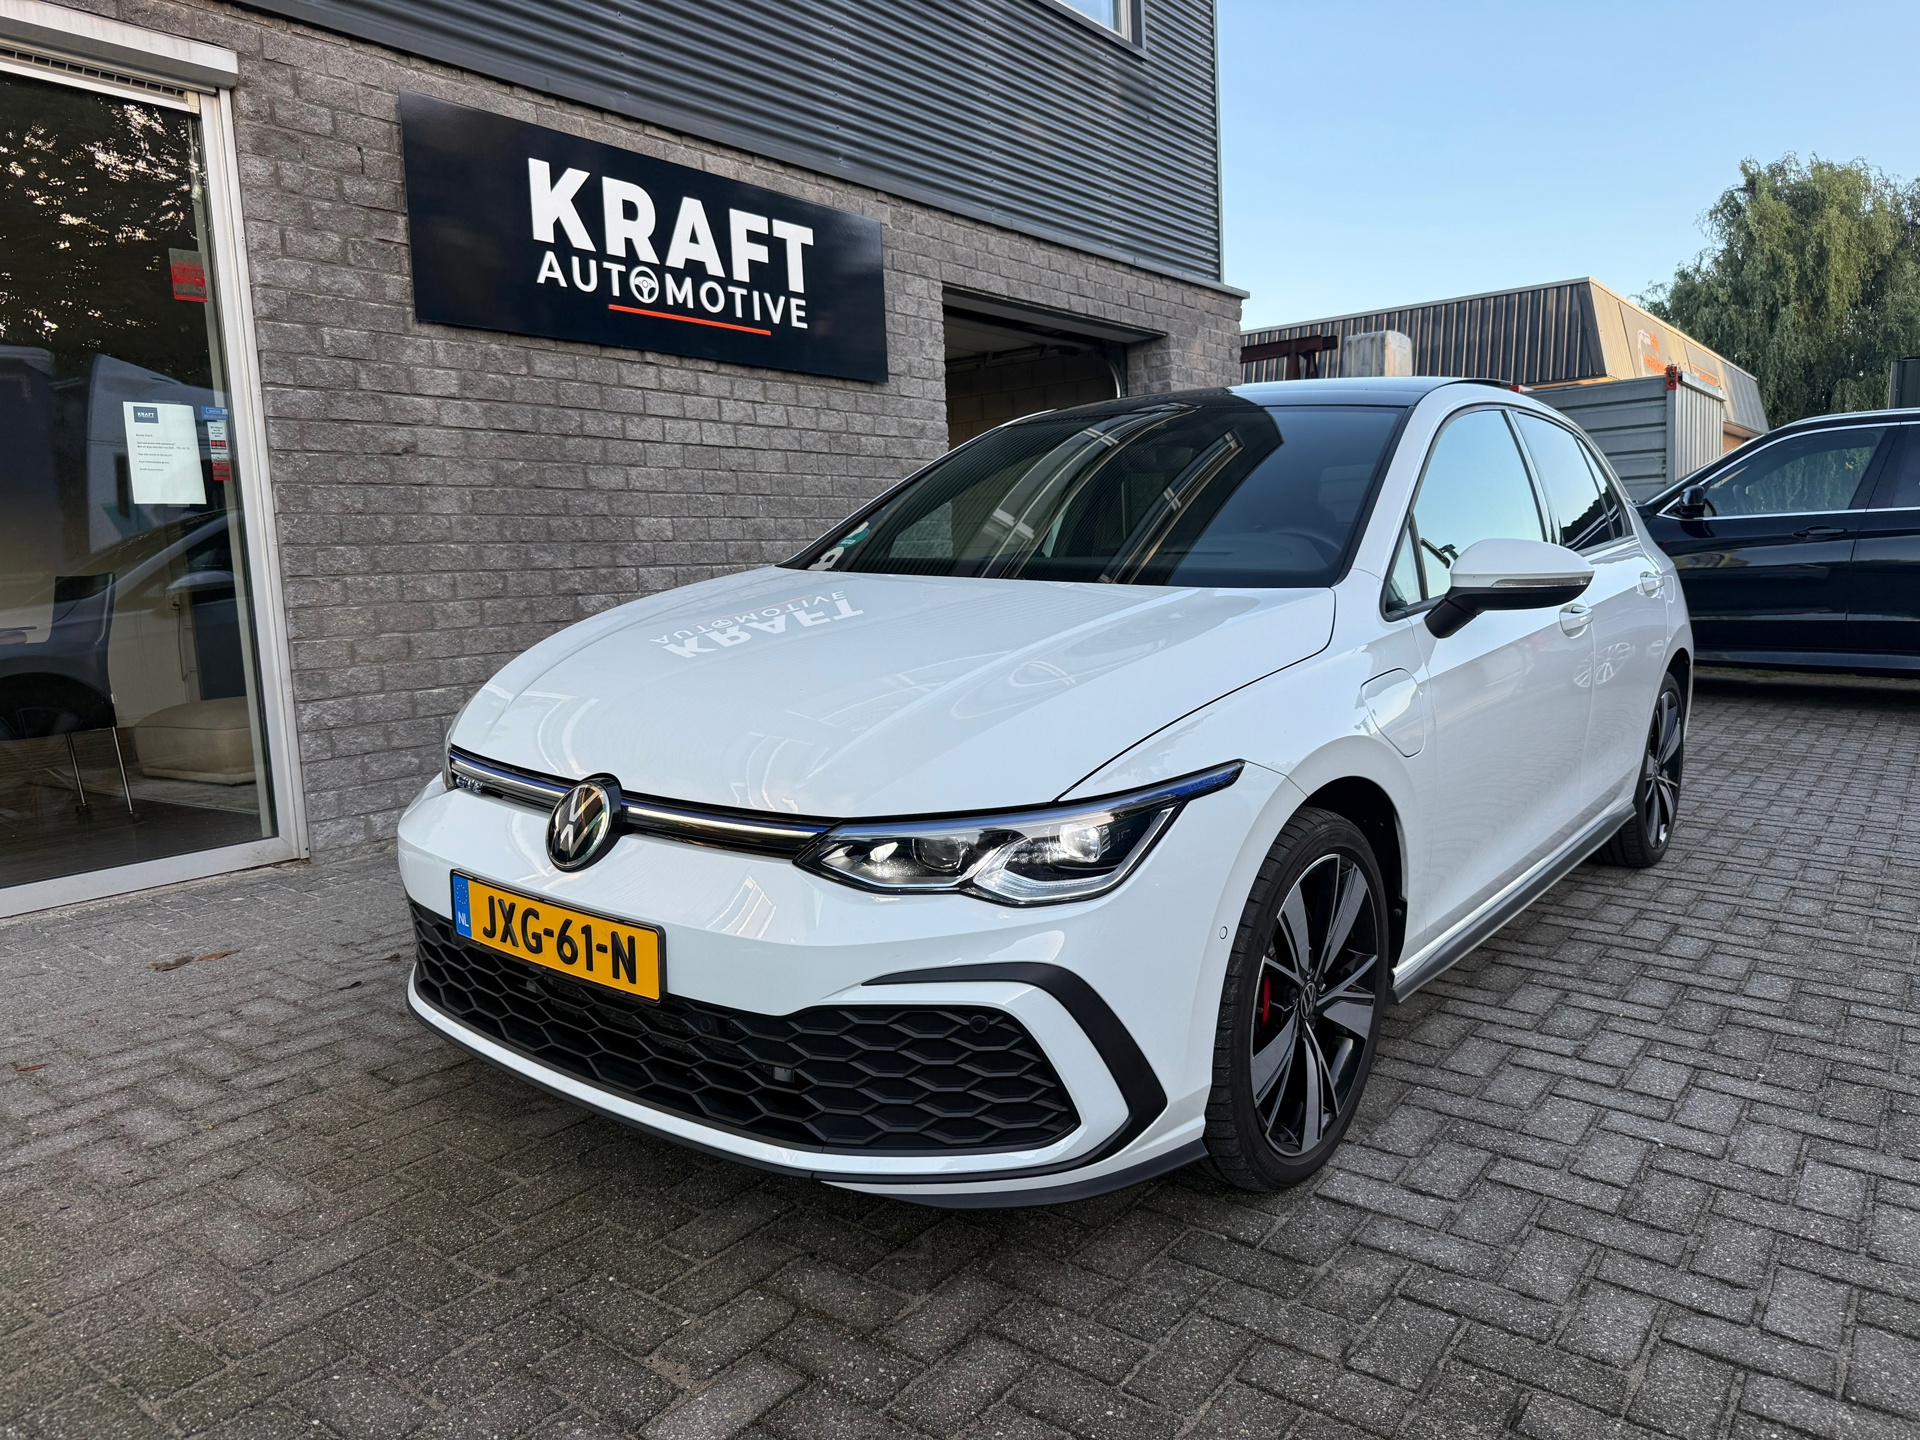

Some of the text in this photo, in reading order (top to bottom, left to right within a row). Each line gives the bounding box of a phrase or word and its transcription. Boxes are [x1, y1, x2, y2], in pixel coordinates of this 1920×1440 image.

[528, 157, 815, 294] KRAFT
[536, 250, 809, 330] AUTOMOTIVE
[458, 911, 470, 928] NL
[482, 895, 637, 985] JXG-61-N
